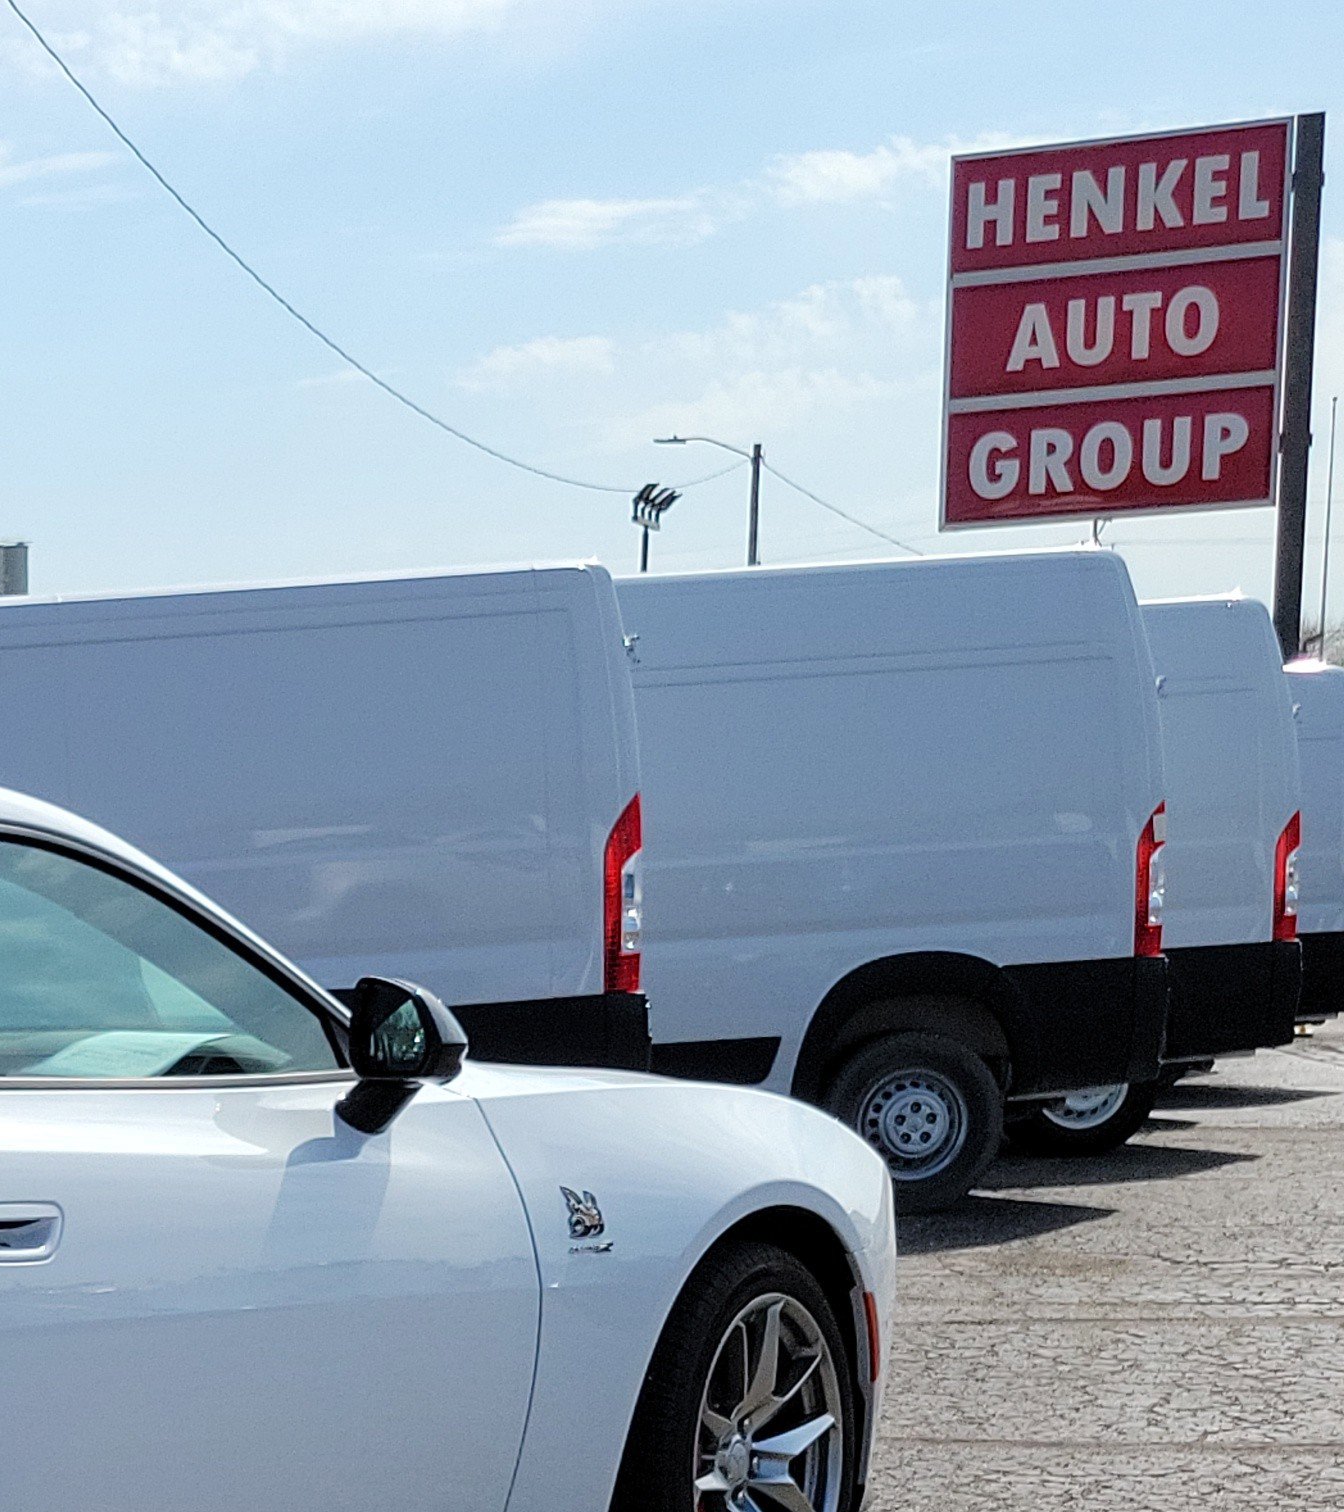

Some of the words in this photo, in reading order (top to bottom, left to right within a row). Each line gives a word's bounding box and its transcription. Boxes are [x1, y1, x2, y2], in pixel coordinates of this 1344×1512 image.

[966, 150, 1270, 249] HENKEL
[1006, 286, 1220, 372] AUTO
[969, 412, 1249, 500] GROUP
